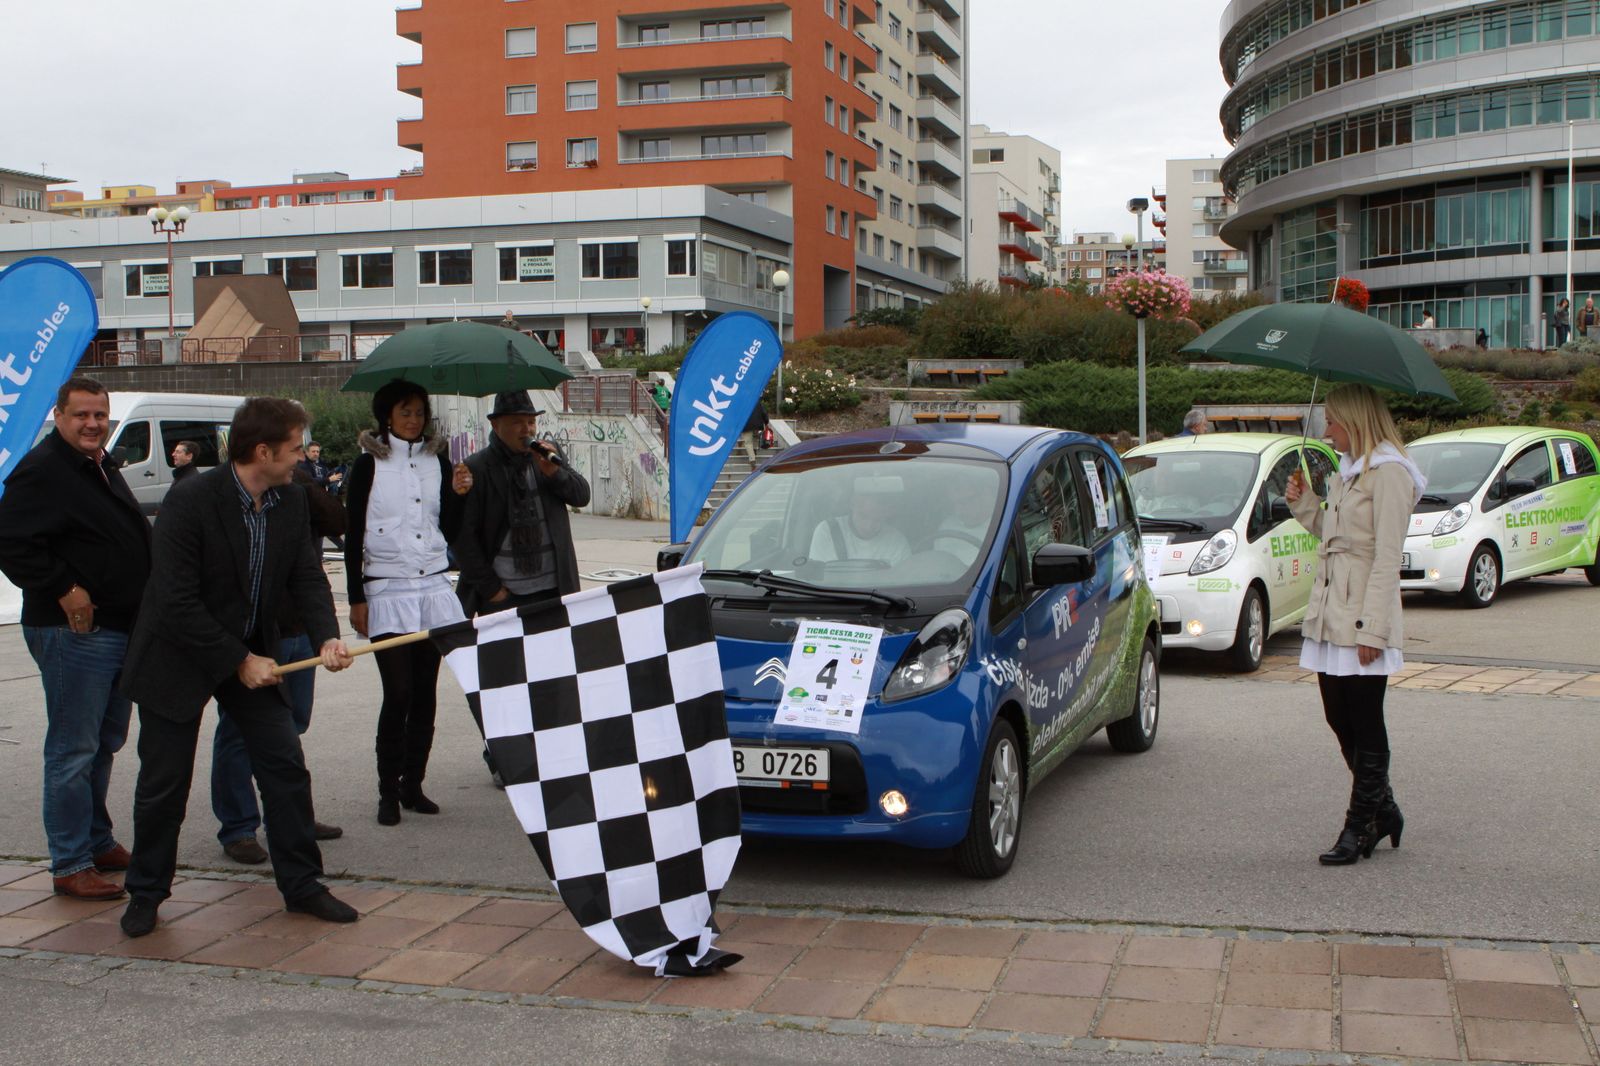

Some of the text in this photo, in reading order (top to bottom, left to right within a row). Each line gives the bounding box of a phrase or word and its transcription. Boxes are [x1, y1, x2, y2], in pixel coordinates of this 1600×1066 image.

[29, 301, 71, 364] cables
[735, 339, 762, 381] cables
[1051, 588, 1079, 640] PRE
[854, 631, 873, 640] 2012
[1075, 616, 1100, 678] emise
[815, 658, 839, 690] 4
[733, 750, 817, 777] B 0726
